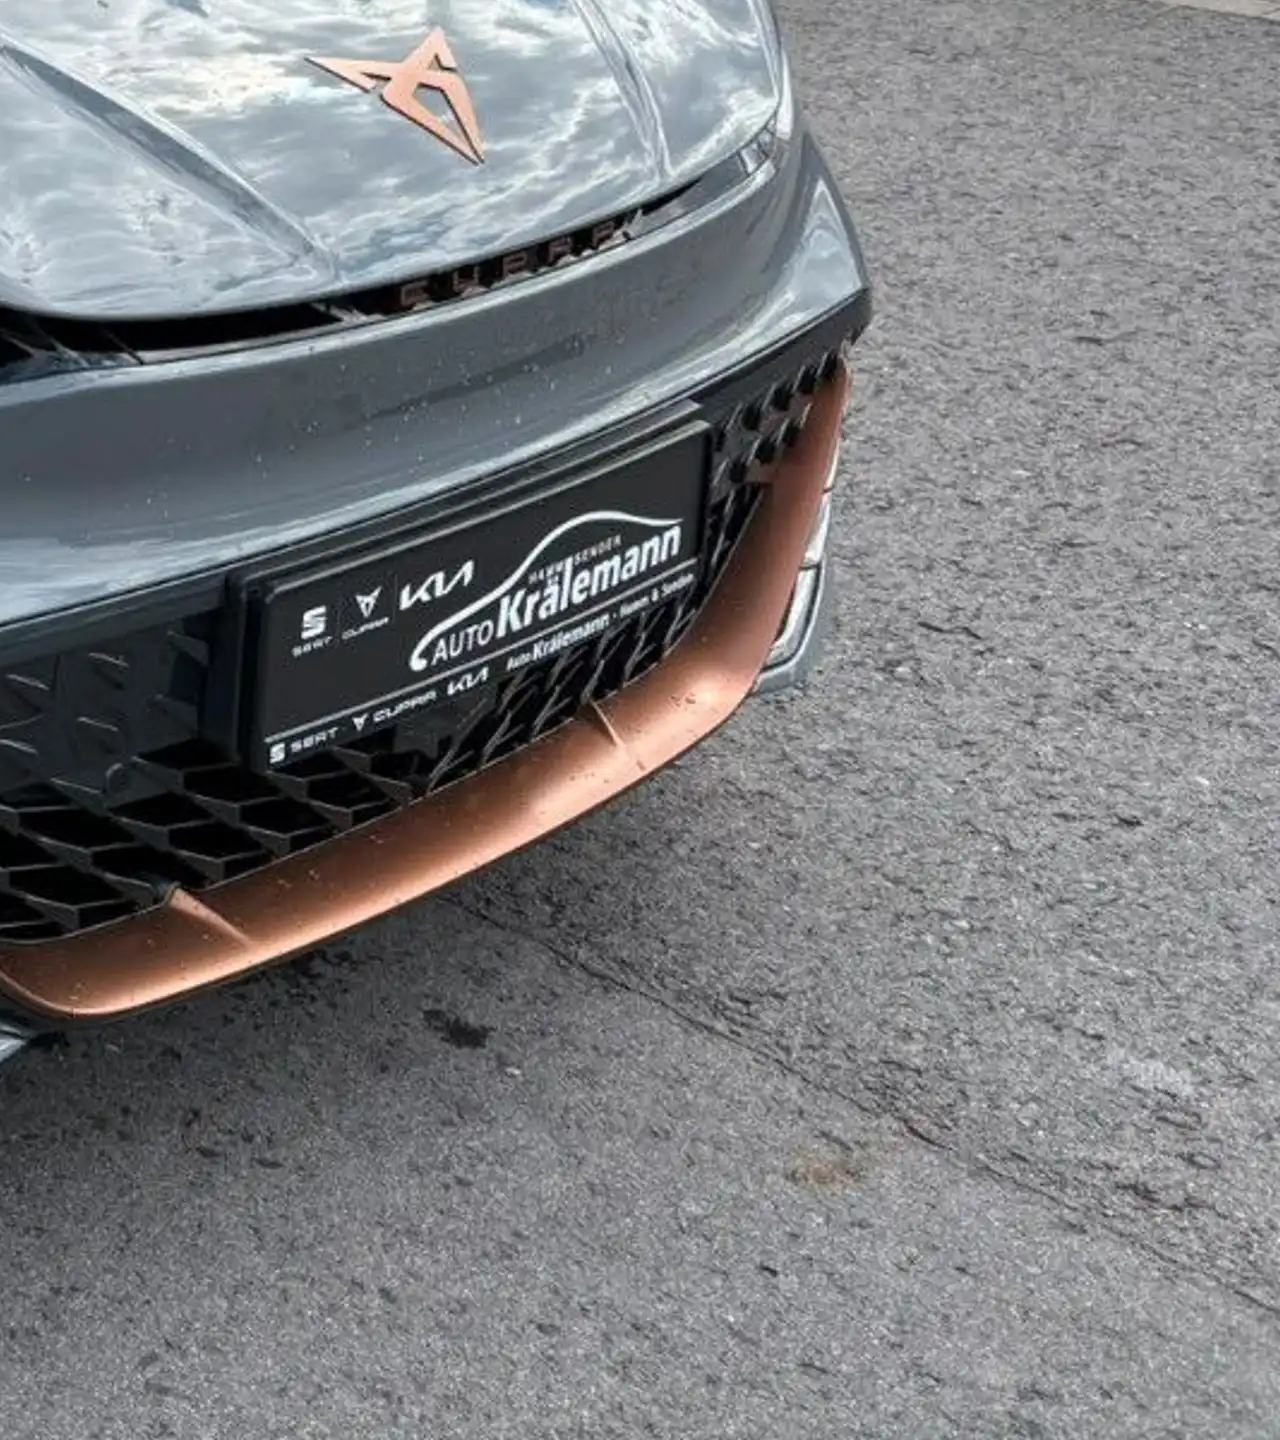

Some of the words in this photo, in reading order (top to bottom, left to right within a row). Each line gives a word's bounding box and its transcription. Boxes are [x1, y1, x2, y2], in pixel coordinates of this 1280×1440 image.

[430, 618, 495, 665] AUTO
[495, 525, 682, 639] Krälemann
[290, 726, 338, 753] SEAT
[372, 690, 437, 723] CUPRA
